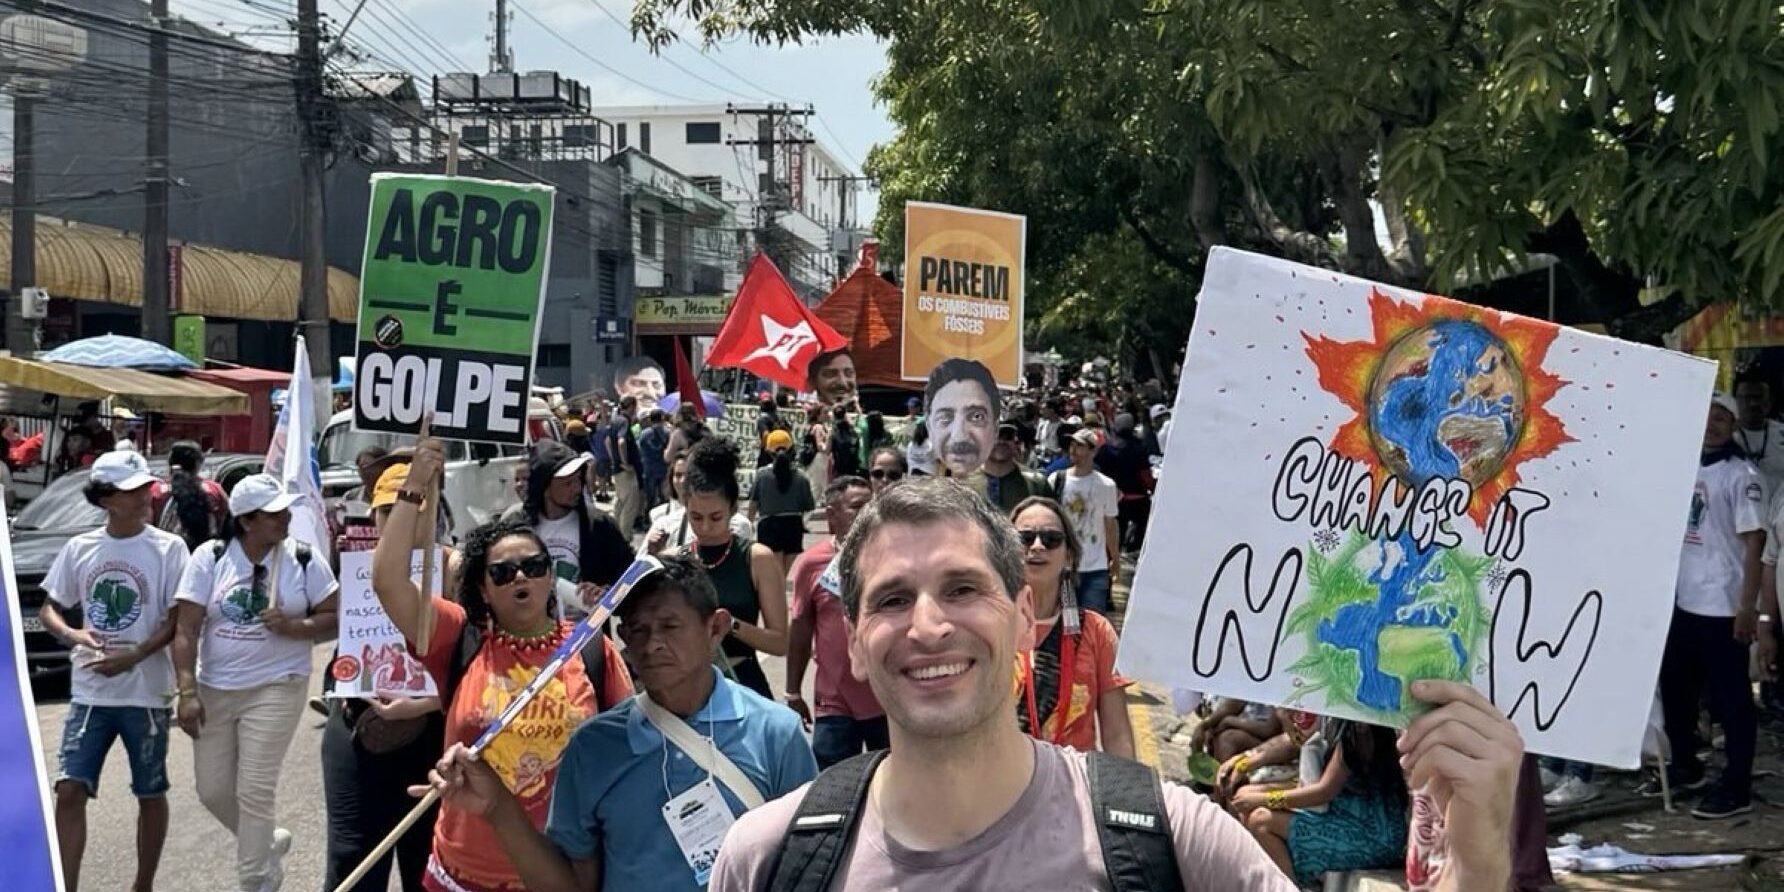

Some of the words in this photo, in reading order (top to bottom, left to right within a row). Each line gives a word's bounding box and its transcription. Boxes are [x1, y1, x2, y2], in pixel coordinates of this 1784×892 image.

[374, 188, 542, 274] AGRO
[920, 256, 1009, 301] PAREM
[433, 280, 463, 336] É
[653, 299, 679, 317] Pop
[918, 296, 933, 312] OS
[935, 297, 1010, 320] COMBUSTÍVEIS
[768, 333, 810, 352] PT
[360, 352, 525, 433] GOLPE
[1272, 435, 1473, 554] CHANGE
[1484, 487, 1551, 561] IT
[1109, 809, 1155, 828] THULE
